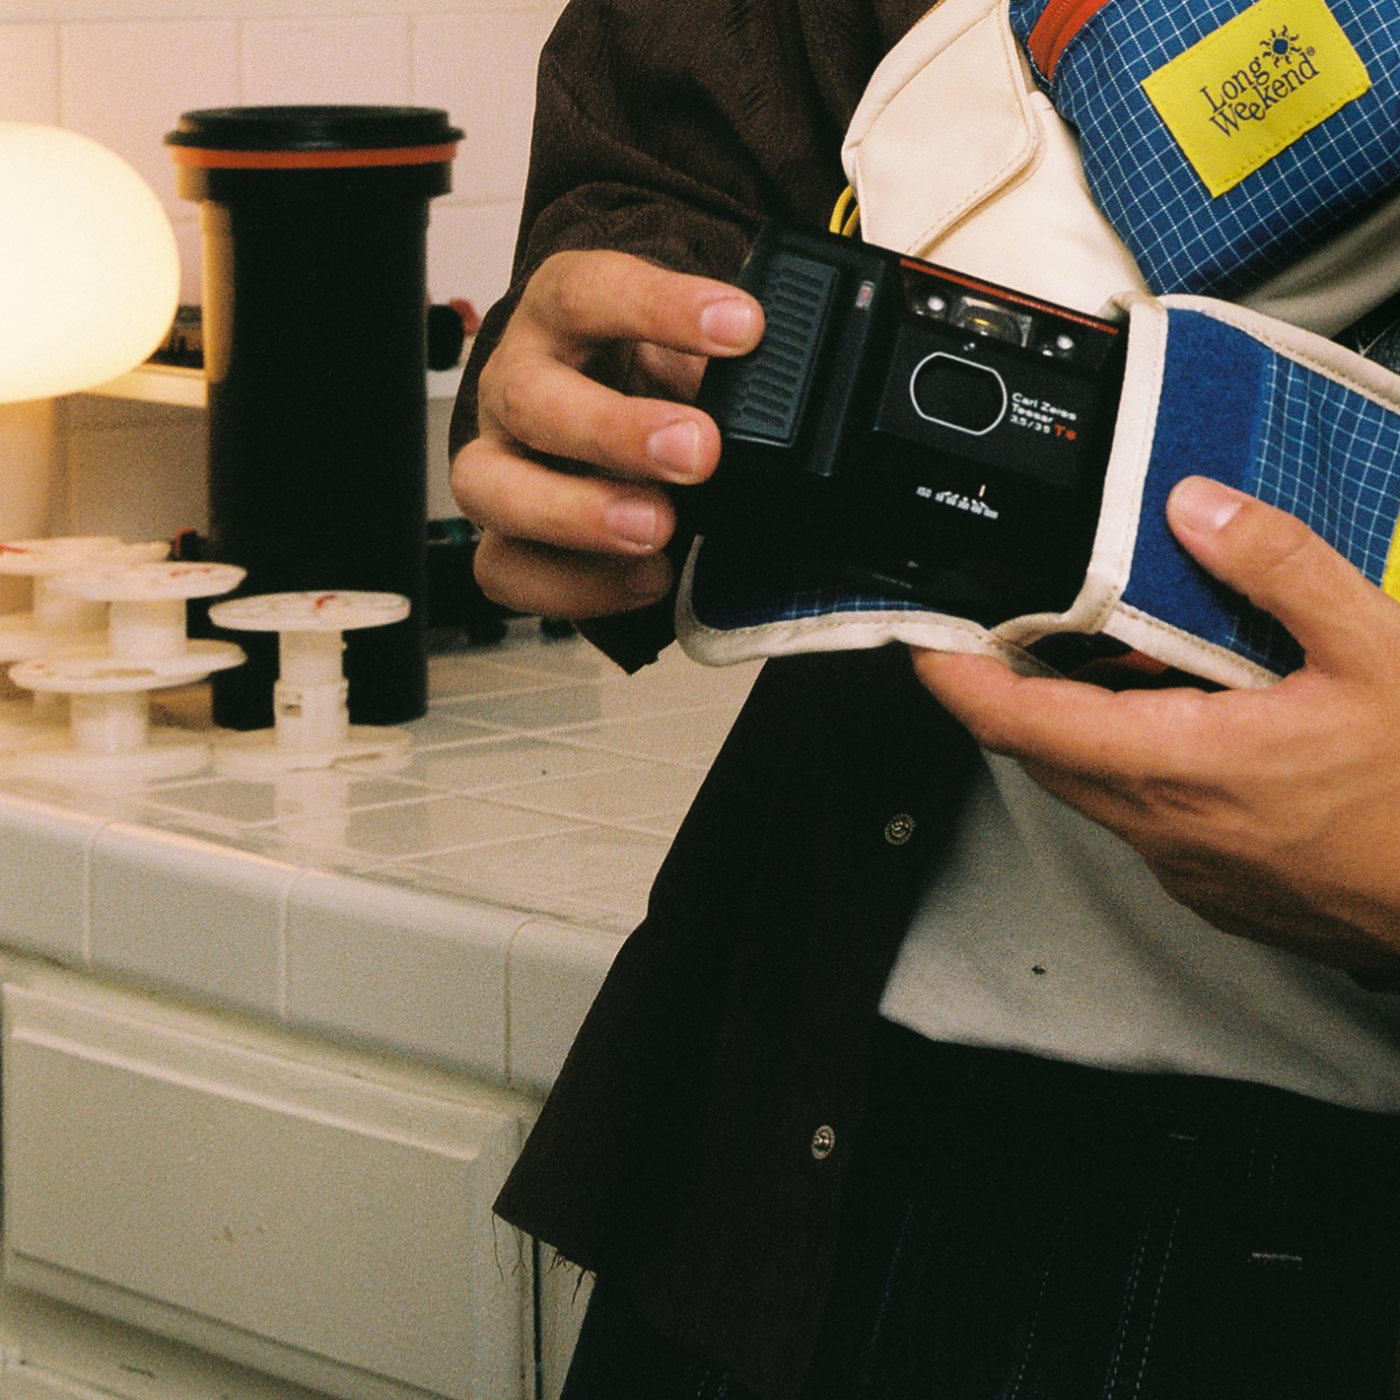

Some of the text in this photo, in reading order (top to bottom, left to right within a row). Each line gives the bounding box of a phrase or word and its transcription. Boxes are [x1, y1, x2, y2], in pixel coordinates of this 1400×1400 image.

[1199, 57, 1272, 114] Long
[1208, 51, 1320, 139] Weekend
[1011, 391, 1039, 409] Carl
